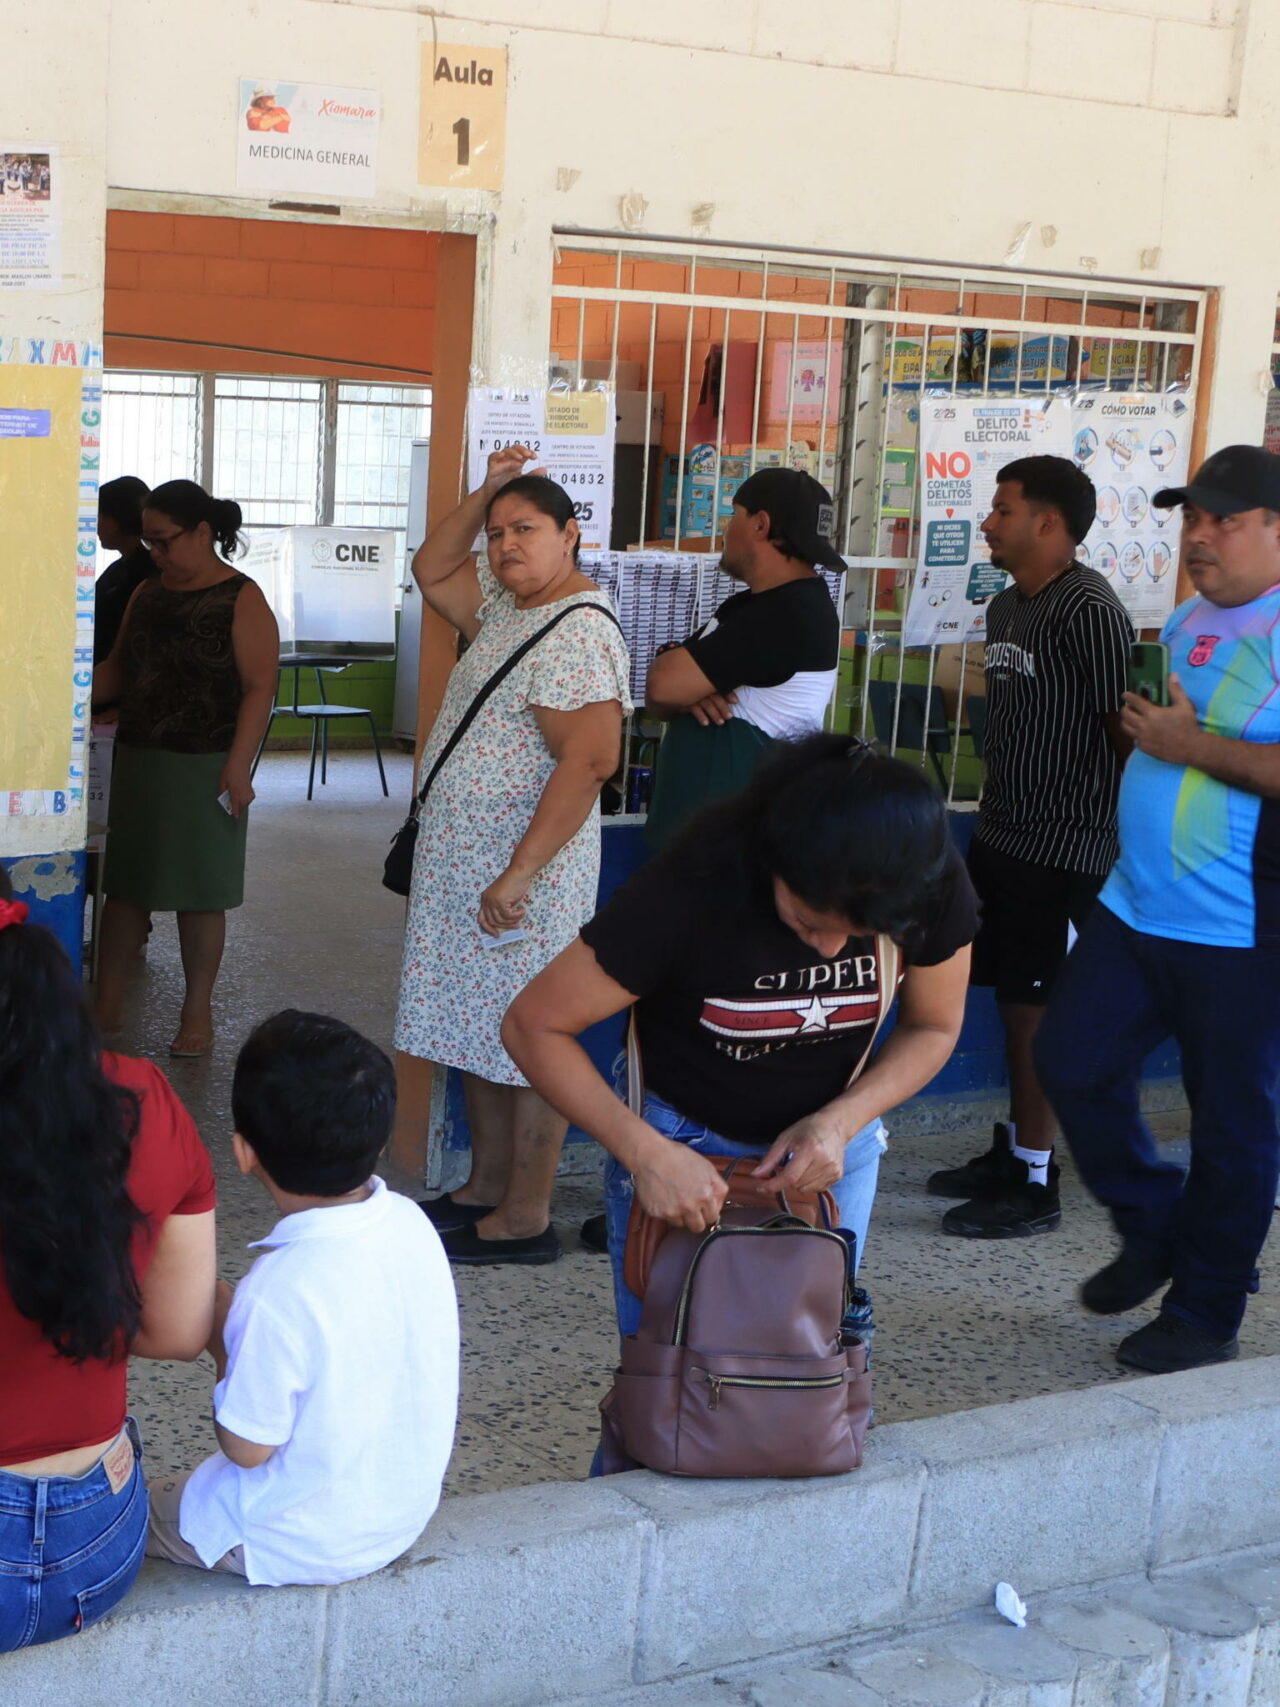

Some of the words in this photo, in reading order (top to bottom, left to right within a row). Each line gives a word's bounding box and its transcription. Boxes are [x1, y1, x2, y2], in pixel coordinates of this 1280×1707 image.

[434, 57, 494, 86] Aula
[318, 100, 376, 119] Xiomara
[453, 117, 471, 166] 1
[249, 144, 314, 162] MEDICINA
[316, 149, 371, 168] GENERAL
[1101, 403, 1127, 416] CÓMO
[1128, 405, 1157, 416] VOTAR
[977, 418, 1018, 429] DELITO
[964, 430, 1031, 443] ELECTORAL
[926, 451, 972, 479] NO
[561, 473, 605, 484] 04832
[927, 480, 972, 489] COMETAS
[927, 489, 972, 499] DELITOS
[335, 543, 380, 563] CNE
[942, 621, 959, 629] CNE
